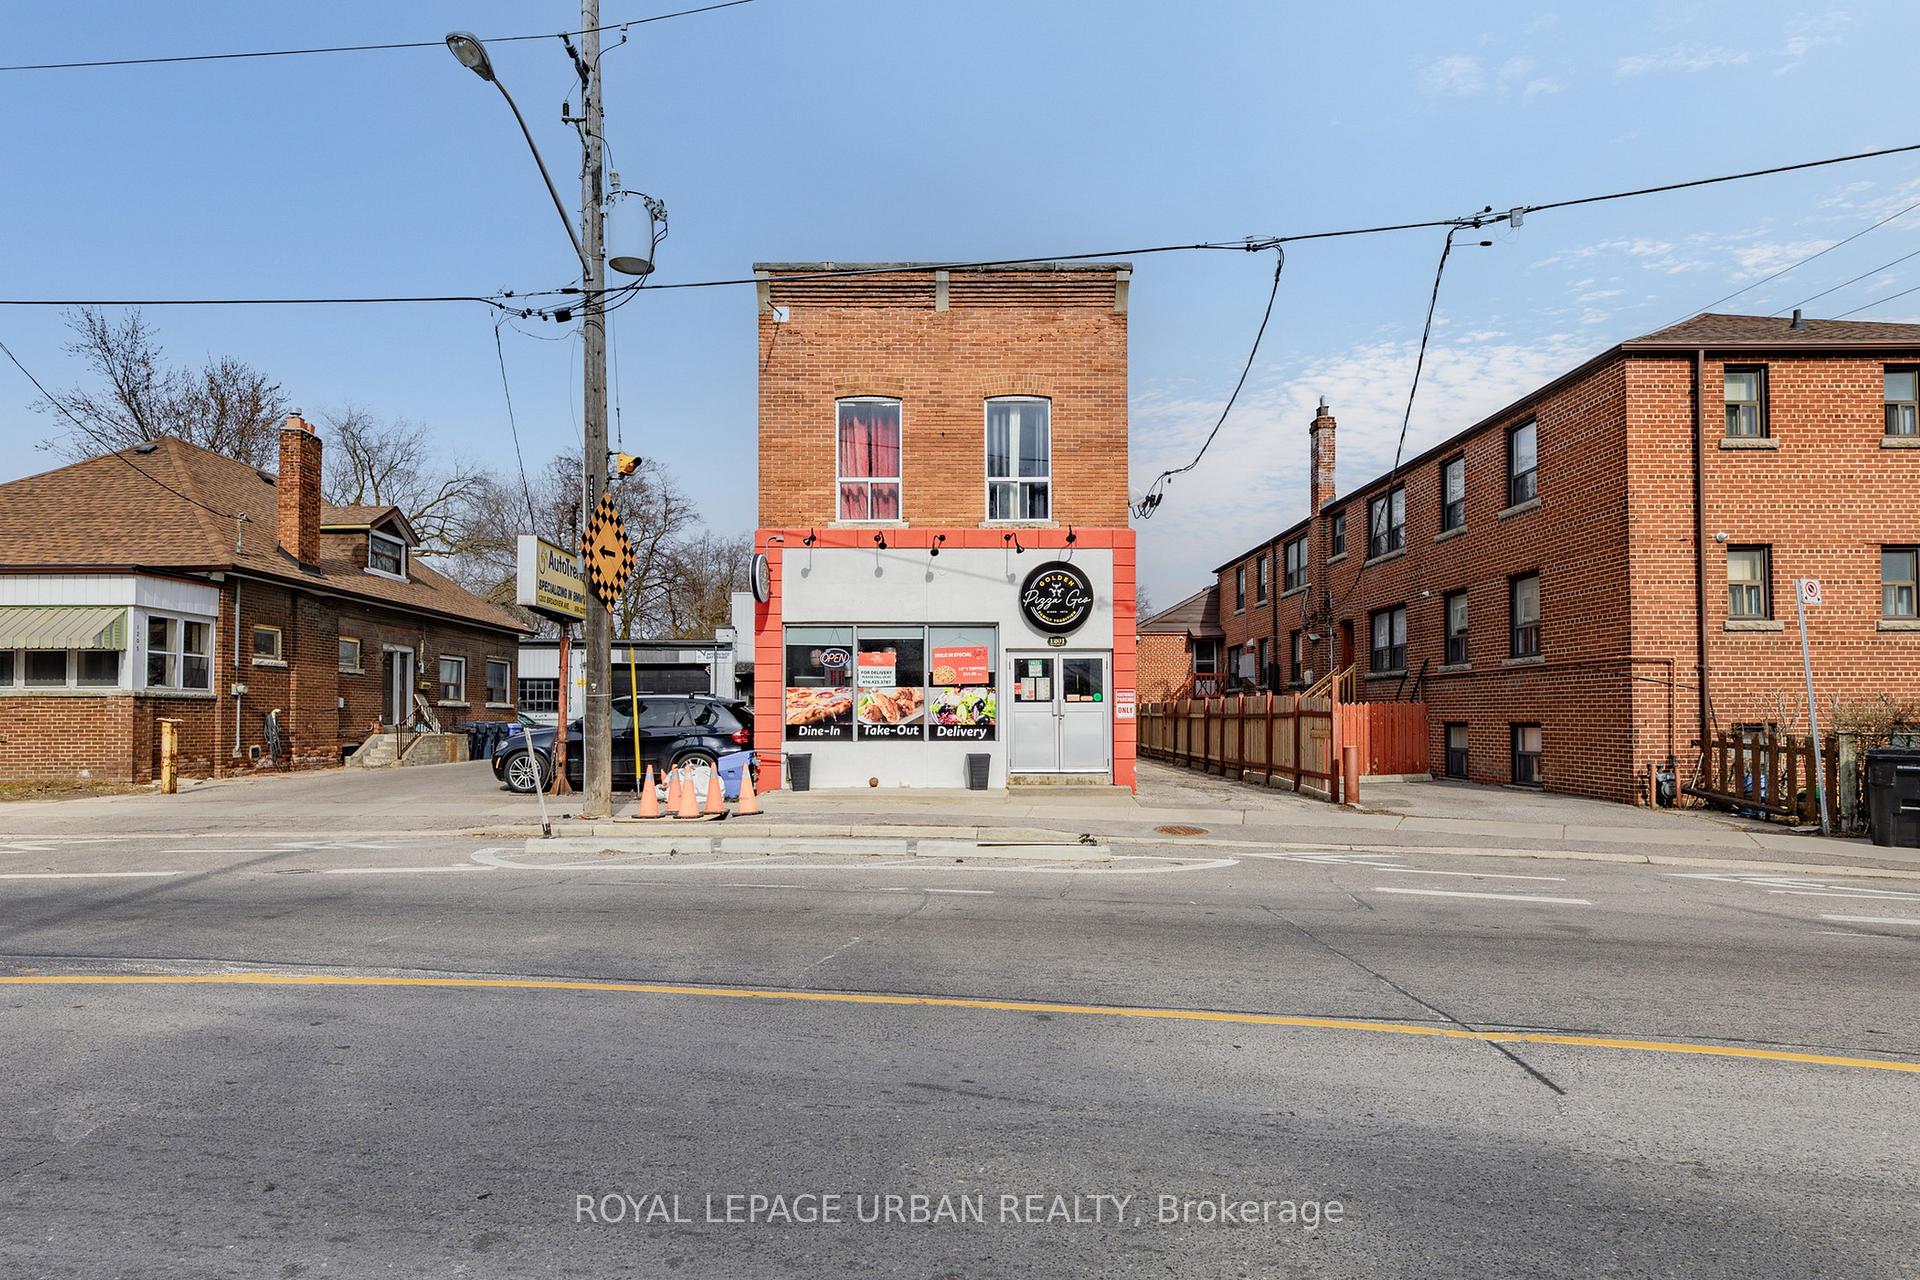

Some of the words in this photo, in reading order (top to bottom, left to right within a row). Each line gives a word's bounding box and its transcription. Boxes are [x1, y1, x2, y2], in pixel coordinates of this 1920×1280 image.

[1040, 575, 1075, 587] GOLDEN
[1022, 589, 1063, 610] Pizza
[1066, 589, 1092, 609] Geo
[822, 653, 847, 663] OPEN
[1117, 706, 1133, 714] ONLY
[798, 725, 841, 736] Dine-In
[862, 724, 920, 736] Take-Out
[936, 725, 987, 739] Delivery
